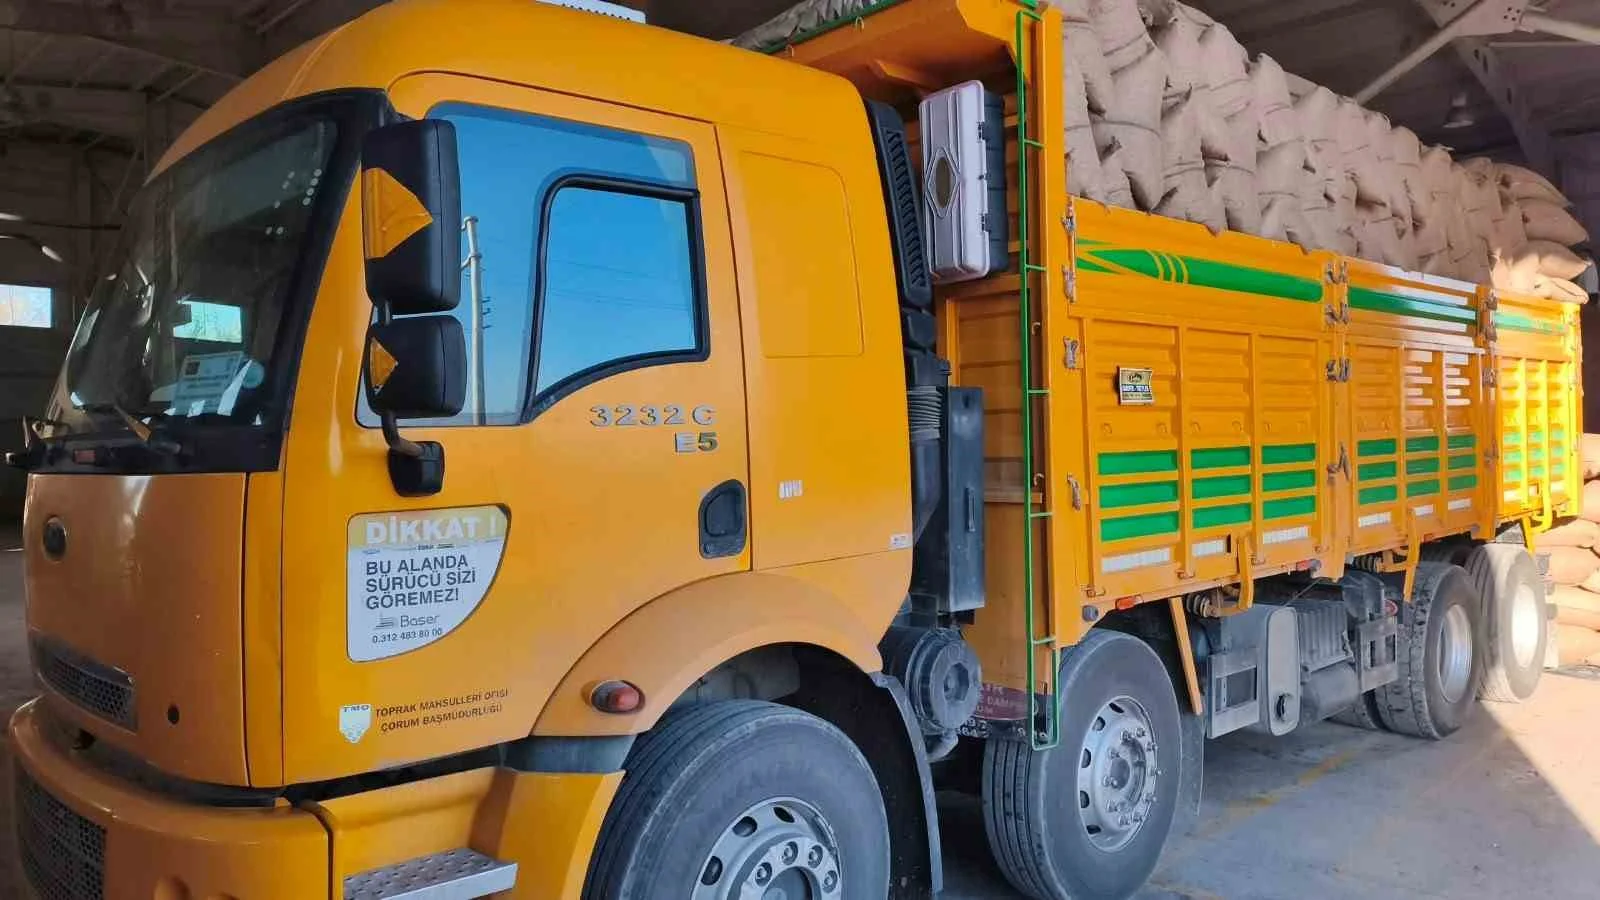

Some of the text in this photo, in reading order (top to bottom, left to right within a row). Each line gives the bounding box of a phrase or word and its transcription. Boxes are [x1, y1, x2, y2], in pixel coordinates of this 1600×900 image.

[674, 431, 719, 453] E5
[366, 514, 481, 545] DİKKAT
[366, 554, 469, 576] BU ALANDA
[366, 566, 476, 593] SÜRÜCÜ SİZİ
[375, 704, 417, 720] TOPRAK
